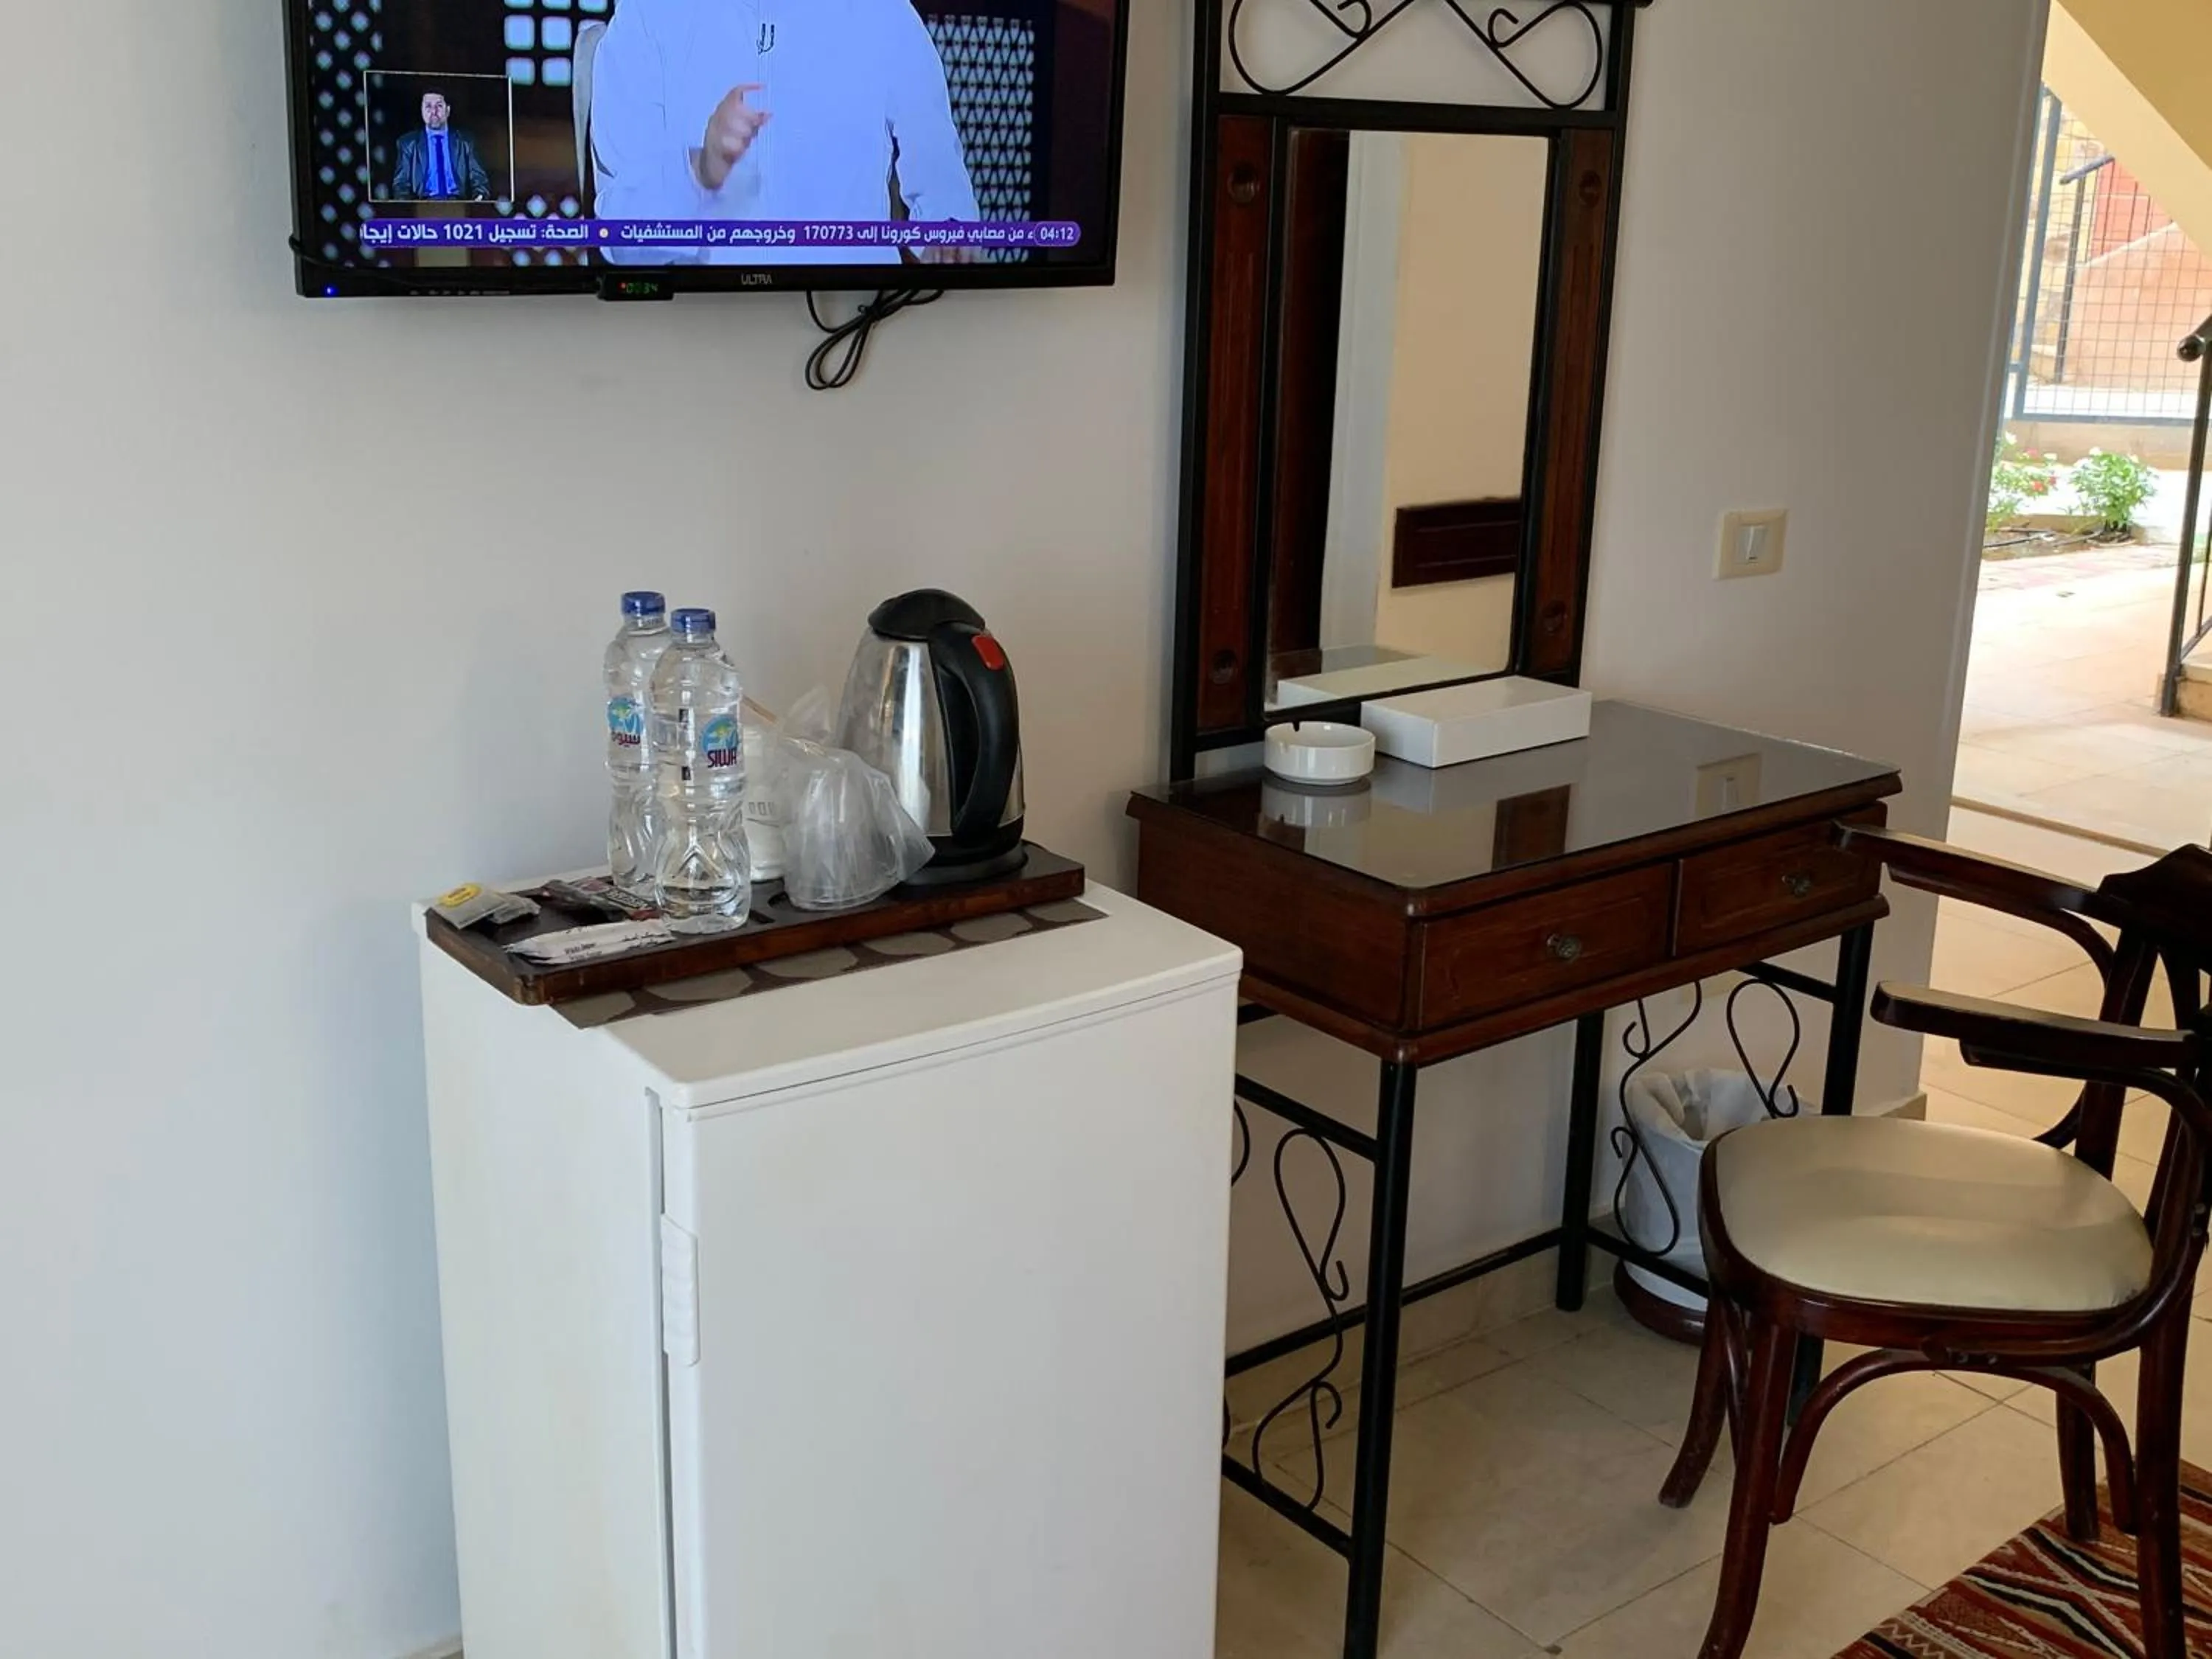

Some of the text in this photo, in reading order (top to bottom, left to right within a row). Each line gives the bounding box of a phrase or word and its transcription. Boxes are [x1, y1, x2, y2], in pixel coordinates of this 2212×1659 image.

[359, 223, 588, 244] الصحة: تسجيل 1021 حالات إيجا
[620, 223, 703, 243] المستشفيات
[707, 225, 726, 243] من
[728, 225, 796, 244] وخروجهم
[803, 225, 853, 240] 170773
[857, 226, 878, 243] إلى
[881, 226, 921, 244] كورونا
[924, 226, 964, 244] فيروس
[967, 227, 1006, 244] مصابي
[1008, 227, 1026, 243] من
[1040, 226, 1074, 240] 04:12
